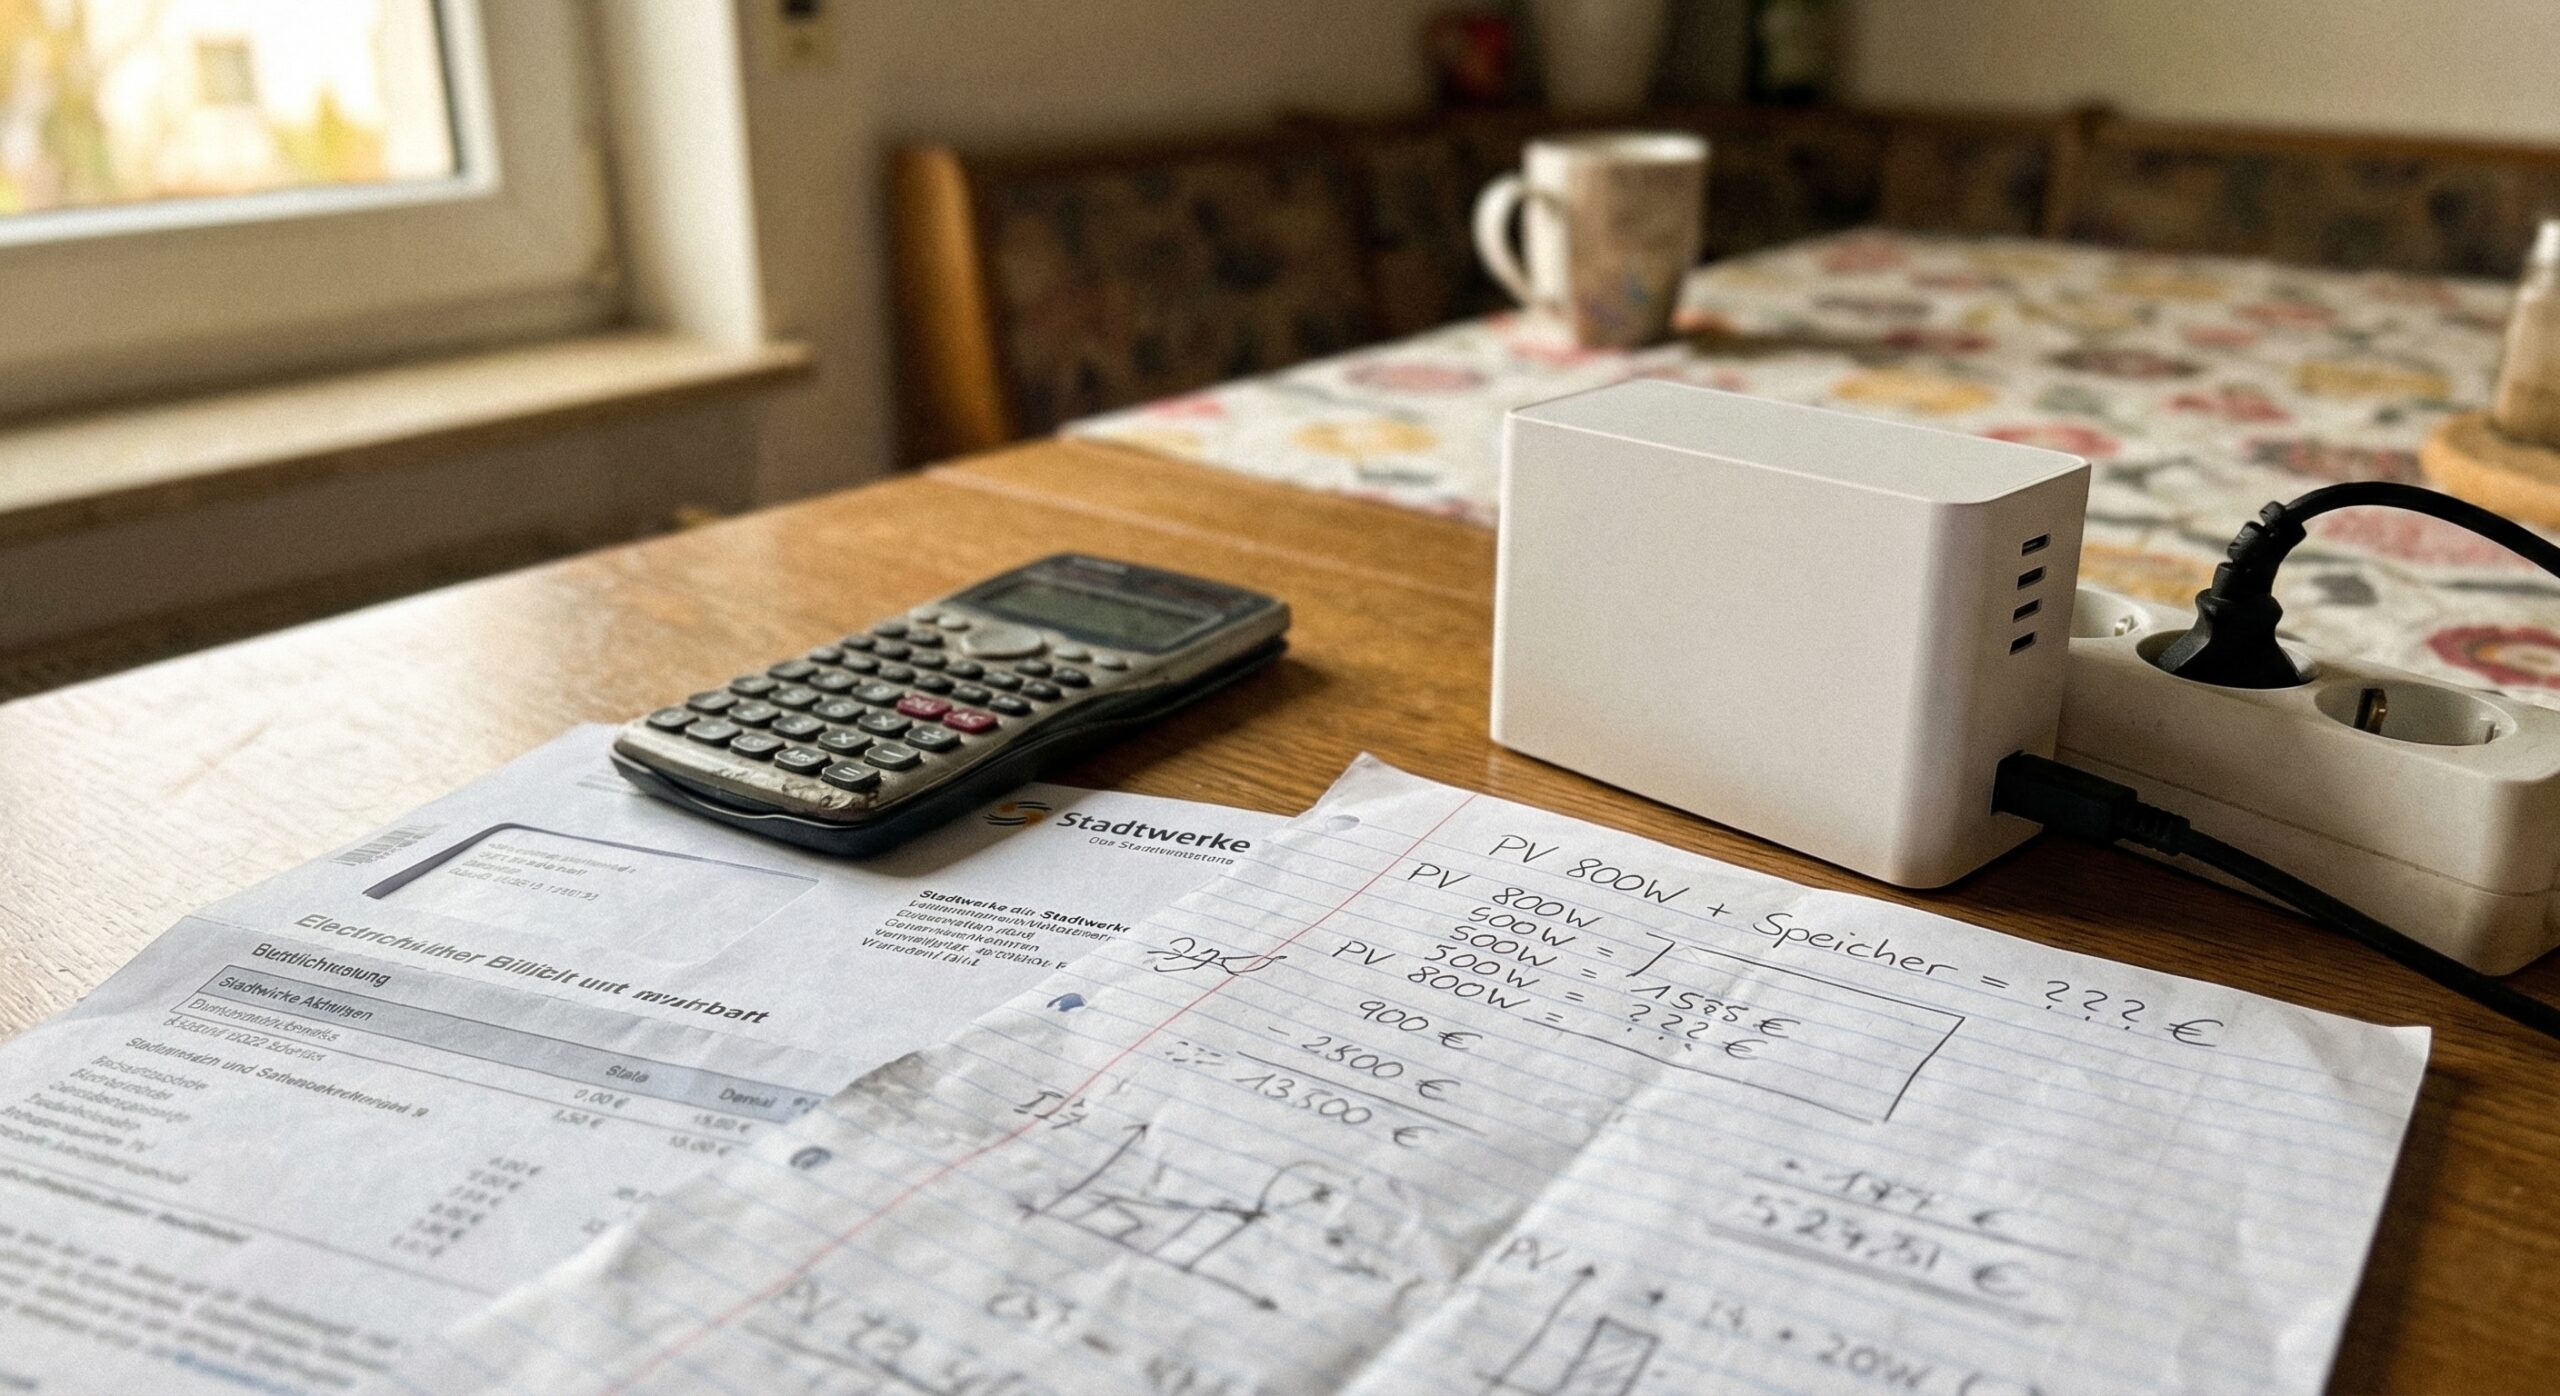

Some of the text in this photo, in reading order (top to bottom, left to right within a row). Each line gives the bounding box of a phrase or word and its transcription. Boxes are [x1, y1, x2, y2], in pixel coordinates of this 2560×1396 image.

[1056, 812, 1251, 853] Stadtwerke
[1407, 862, 1604, 928] PV 800W
[1467, 906, 1576, 947] 500W
[1489, 834, 1559, 863] PV
[1566, 858, 1690, 903] 800W
[1706, 902, 1732, 918] +
[1752, 911, 1959, 978] Speicher
[1981, 974, 2009, 990] =
[2168, 1018, 2224, 1048] €
[1332, 940, 1396, 965] PV
[1407, 966, 1531, 1009] 800W
[1424, 944, 1540, 988] 500W
[1722, 1038, 1769, 1060] €
[1450, 925, 1557, 967] 500W
[1753, 1017, 1801, 1039] €
[1359, 1000, 1483, 1050] 900 €
[1416, 1079, 1461, 1101] €
[1392, 1126, 1440, 1149] €
